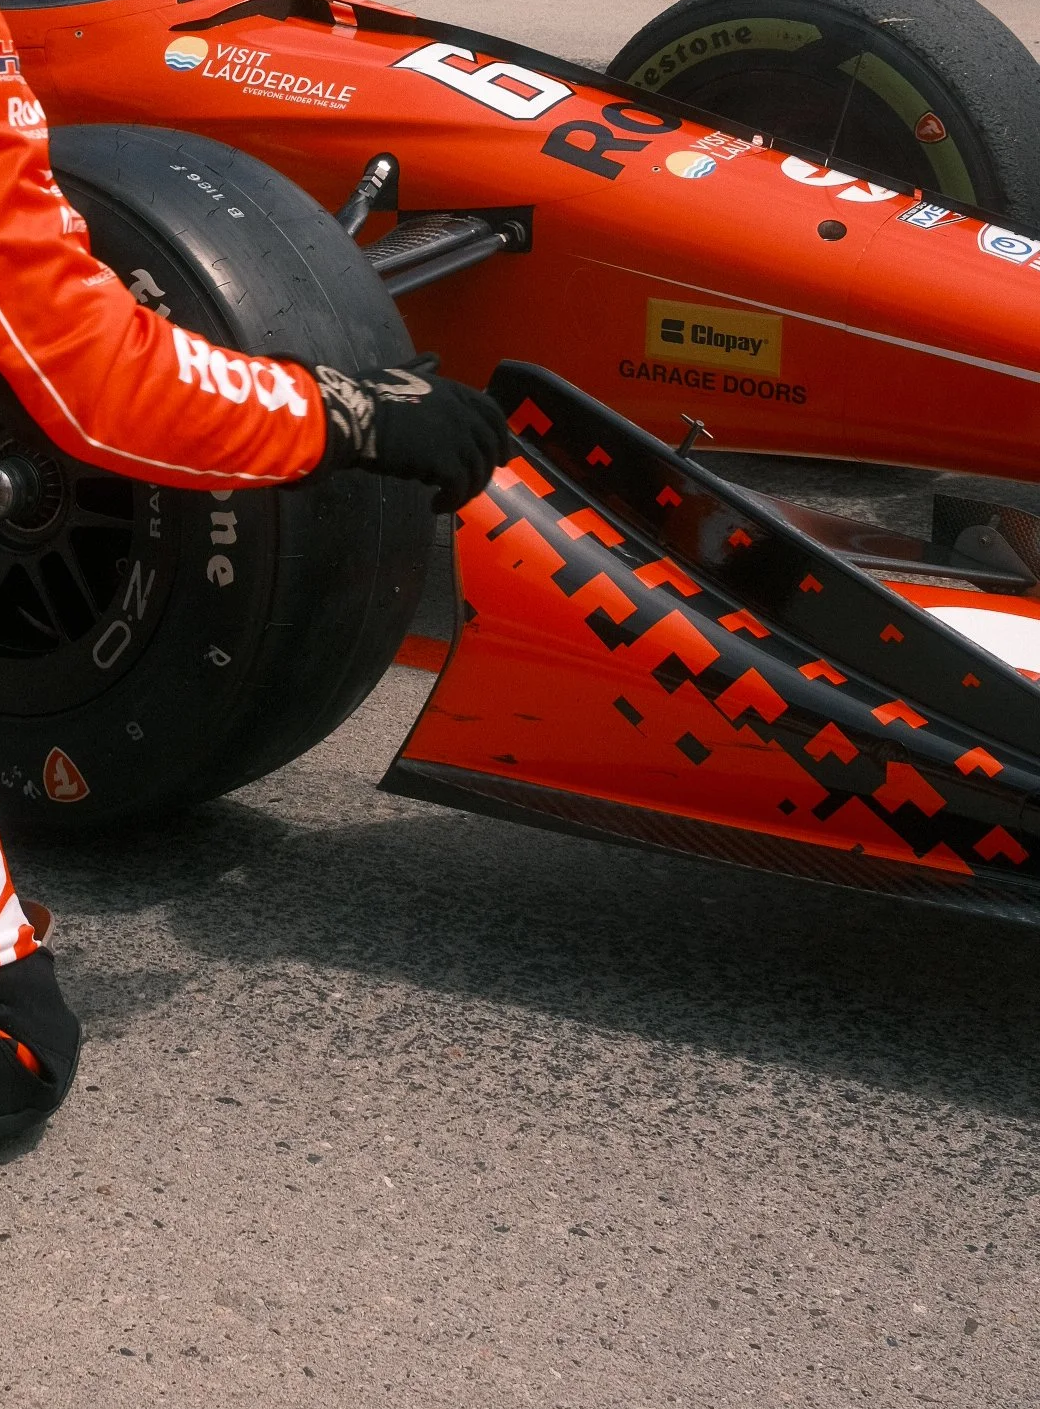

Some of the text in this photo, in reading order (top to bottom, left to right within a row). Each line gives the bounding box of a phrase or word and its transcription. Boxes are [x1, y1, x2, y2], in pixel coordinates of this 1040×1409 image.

[216, 43, 271, 67] VISIT
[633, 25, 754, 89] estone
[202, 59, 357, 103] LAUDERDALE
[242, 86, 346, 111] EVERYONE UNDER THE SUN
[540, 102, 684, 181] RO
[689, 130, 736, 152] VISIT
[691, 324, 764, 356] Clopay
[619, 359, 807, 405] GARAGE DOORS
